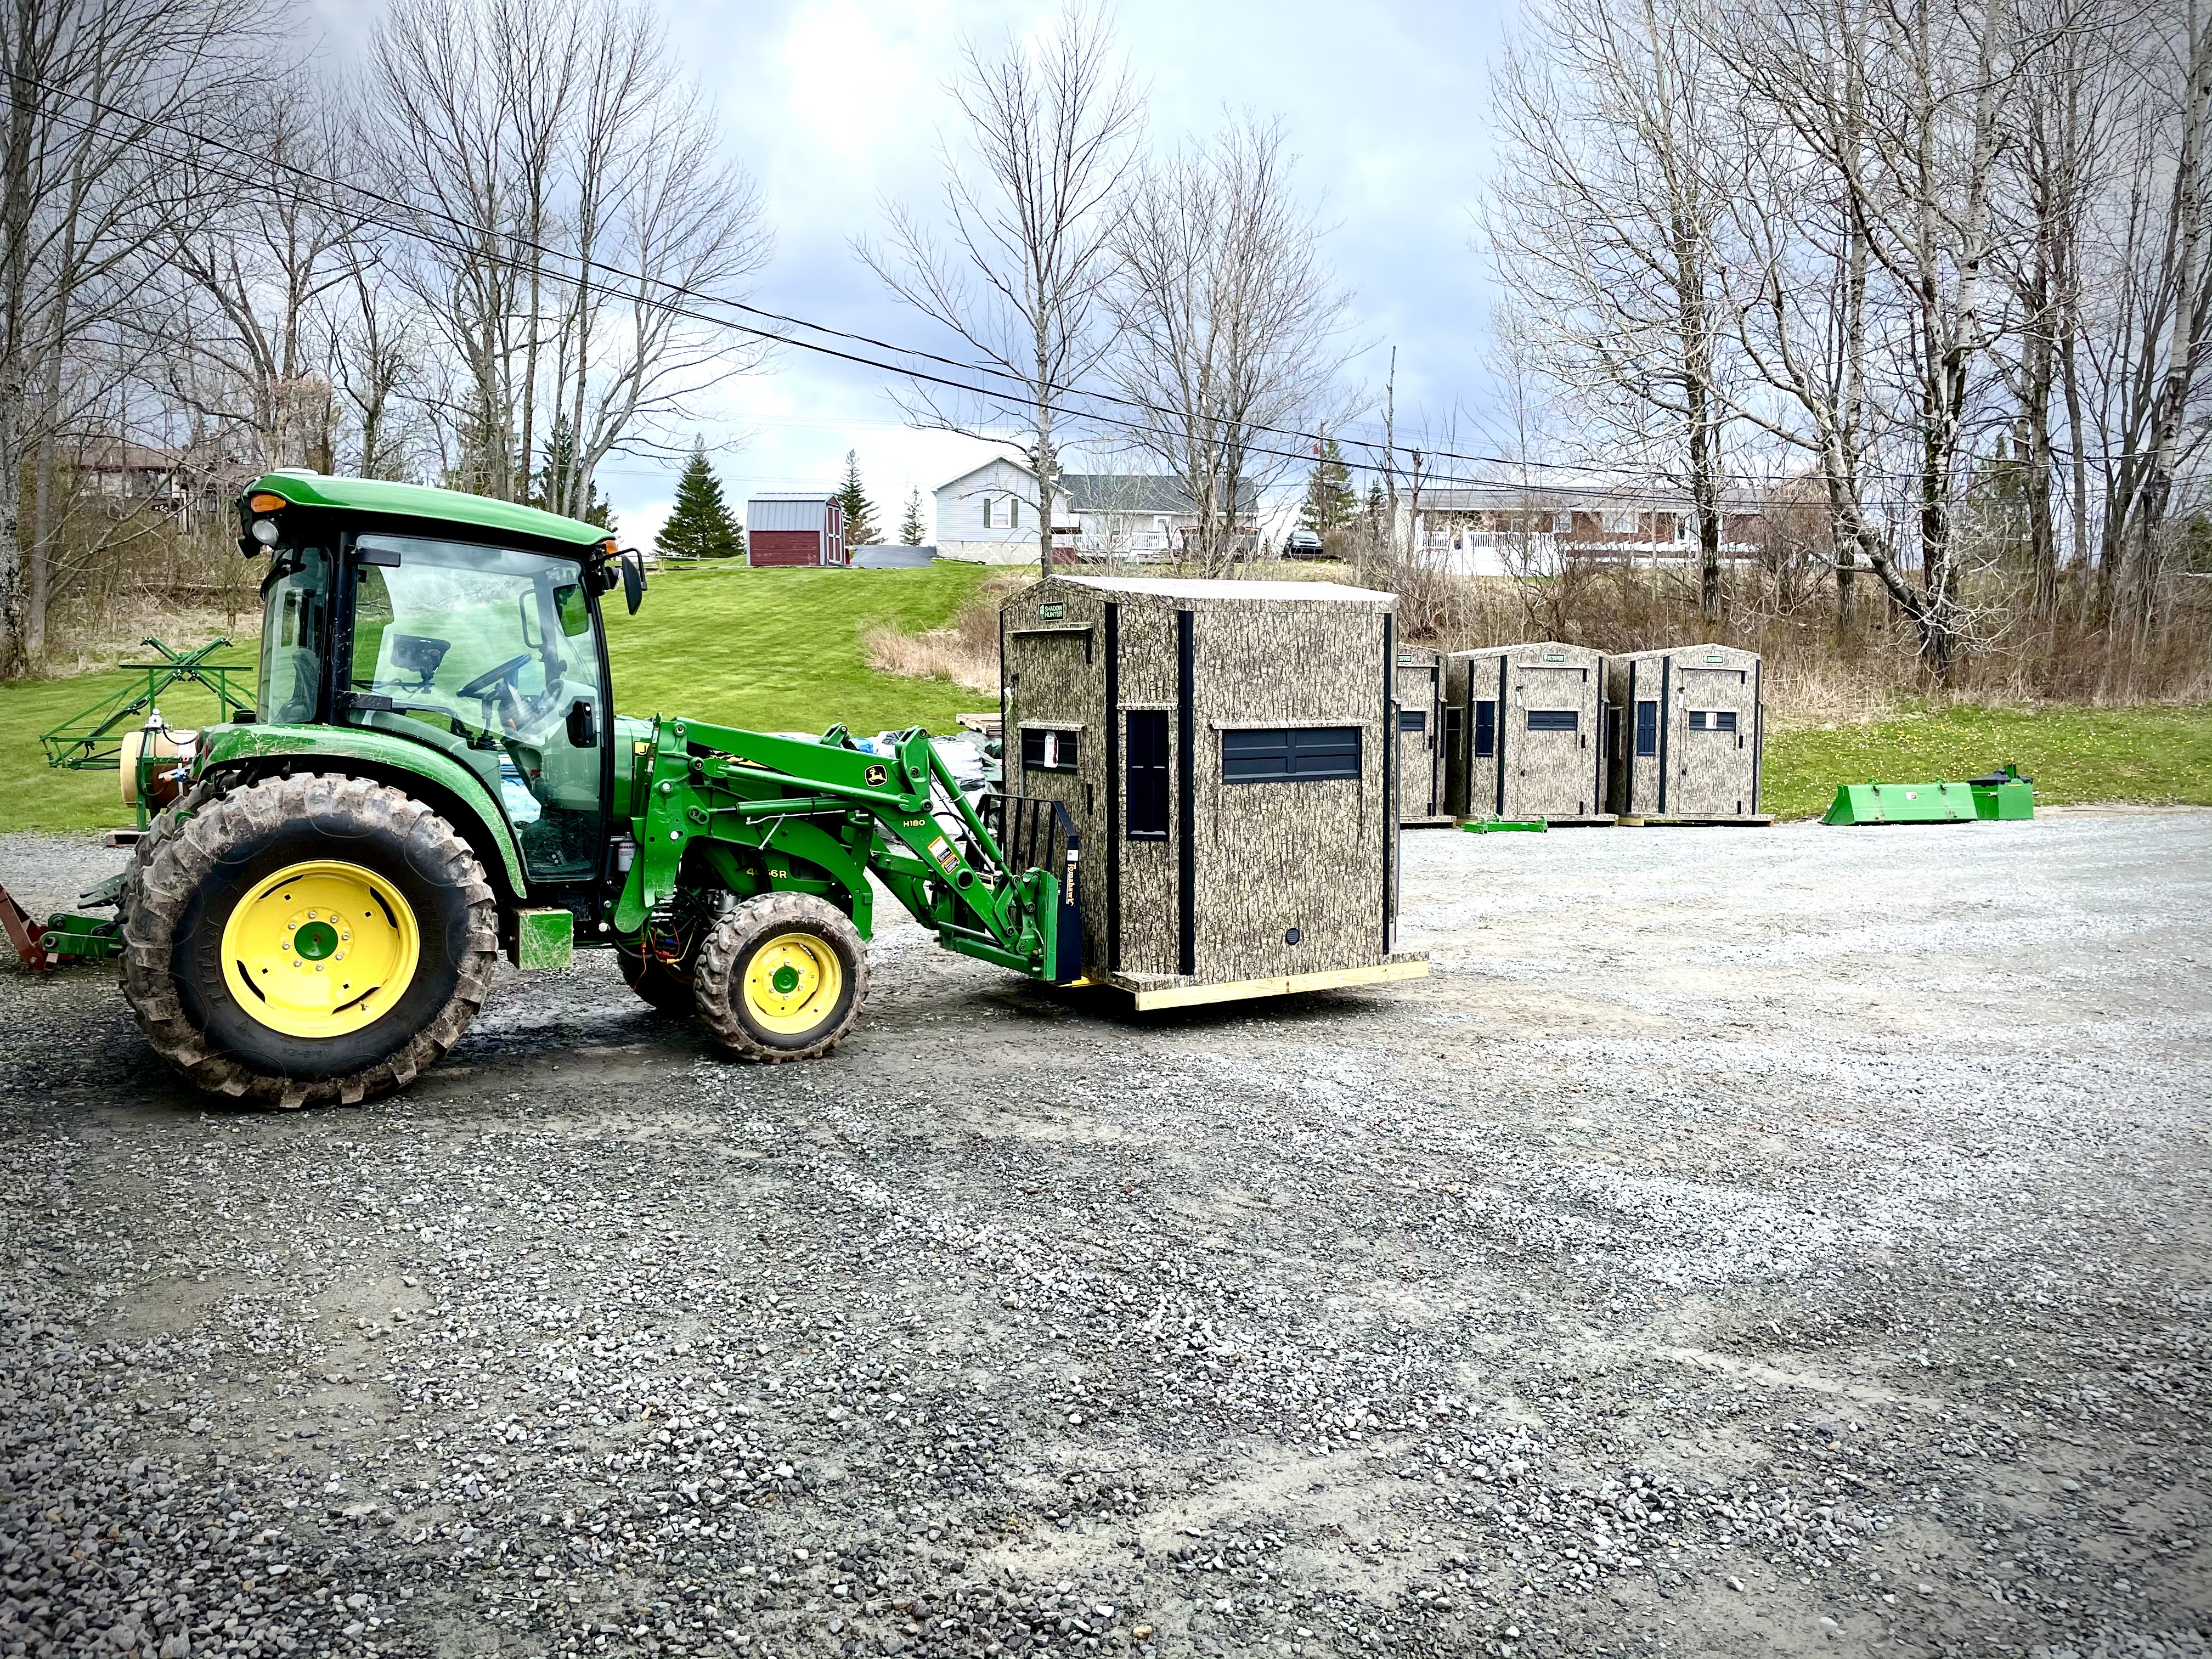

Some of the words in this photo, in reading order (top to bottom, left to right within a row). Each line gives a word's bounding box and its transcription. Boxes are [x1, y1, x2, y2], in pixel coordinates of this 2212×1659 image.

[903, 819, 926, 827] H180
[1068, 862, 1076, 906] Tomahawk
[198, 917, 228, 1009] TITAN
